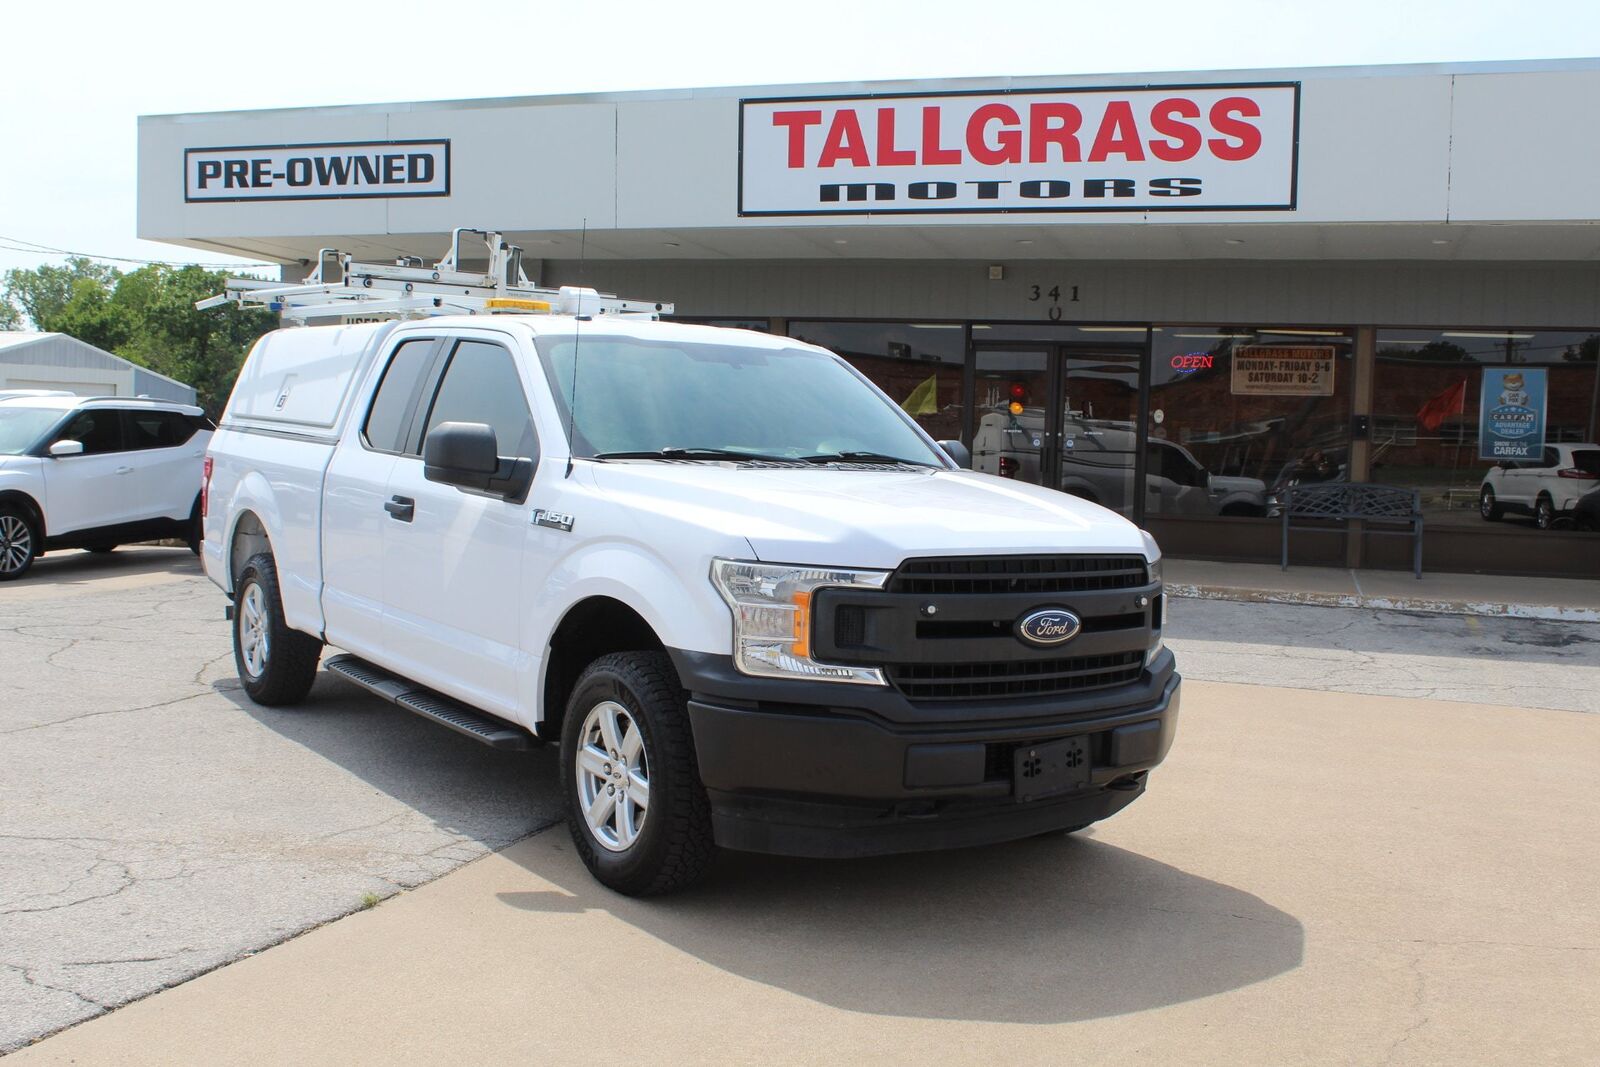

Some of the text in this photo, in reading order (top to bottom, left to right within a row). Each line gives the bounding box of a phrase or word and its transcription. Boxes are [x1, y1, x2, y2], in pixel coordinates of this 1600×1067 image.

[772, 96, 1262, 169] TALLGRASS
[197, 153, 435, 190] PRE-OWNED
[819, 177, 1203, 203] MOTORS
[1171, 355, 1213, 368] OPEN
[1248, 373, 1319, 384] SATURDAY 10-2
[1493, 447, 1528, 455] CARFAX
[1036, 617, 1068, 635] Ford
